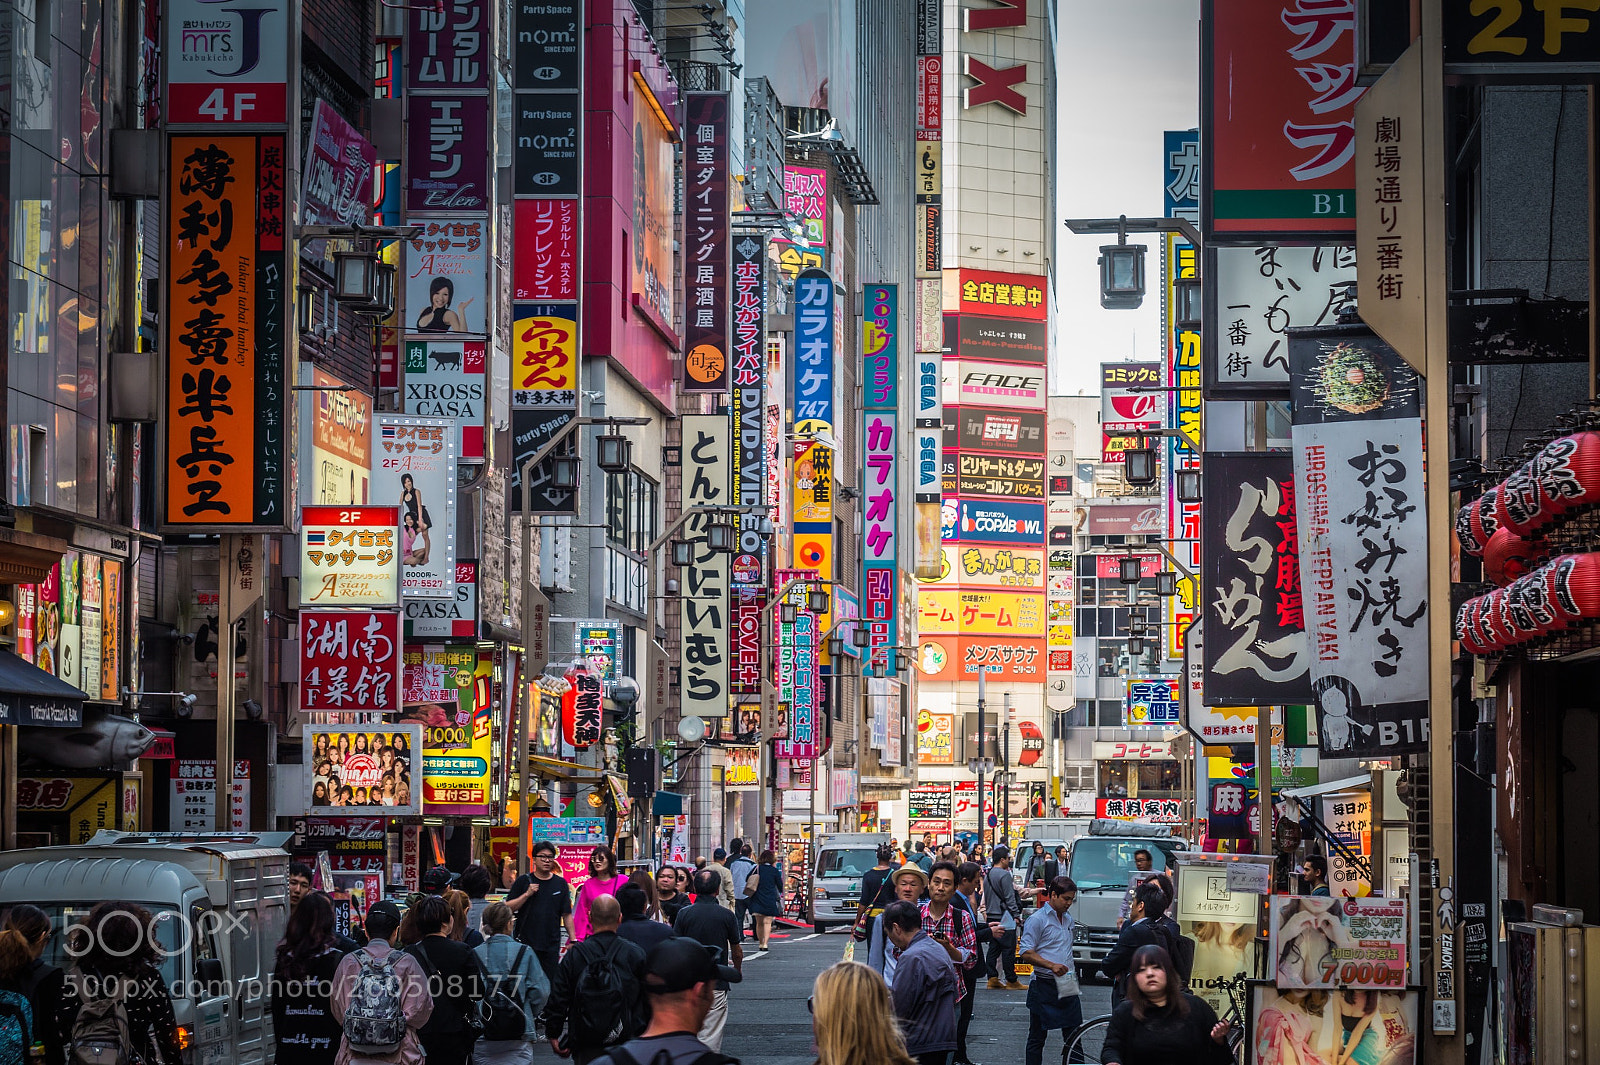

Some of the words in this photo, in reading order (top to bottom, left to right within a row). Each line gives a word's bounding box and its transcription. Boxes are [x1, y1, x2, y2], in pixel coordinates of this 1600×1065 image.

[523, 5, 545, 15] Party
[546, 6, 572, 16] Space
[1466, 0, 1600, 55] 2F
[452, 0, 481, 83] ンタル
[182, 54, 234, 62] Kabukicho
[539, 67, 554, 78] 4F
[198, 88, 257, 121] 4F
[523, 110, 545, 120] Party
[546, 110, 572, 121] Space
[430, 101, 463, 179] エデン
[539, 174, 555, 183] 3F
[260, 146, 283, 237] 炭火串焼
[424, 183, 481, 208] Eden
[787, 196, 822, 219] 求人
[1312, 194, 1347, 214] B1
[1374, 116, 1404, 301] 劇場通り一番街
[427, 223, 481, 237] タイ古式
[560, 201, 571, 258] レンタルルーム
[694, 124, 715, 328] 個室ダイニング居酒屋
[411, 239, 481, 252] マッサージ
[534, 201, 553, 298] リフレッシュ
[238, 255, 250, 293] Hakuri
[560, 261, 571, 294] ホステル
[516, 289, 529, 298] 2F
[962, 280, 1043, 308] 全店営業中
[237, 296, 249, 324] tabai
[734, 261, 761, 385] ホテルがライバル
[799, 279, 829, 396] カラオケ
[979, 330, 1006, 338] しゃぶしゃぶ
[1225, 303, 1252, 378] 一番街
[234, 327, 248, 367] hanbey
[410, 346, 424, 360] 肉
[464, 349, 485, 358] イタリ
[962, 338, 1043, 351] Mo-Mo-Paradise
[408, 359, 425, 368] バル
[467, 357, 482, 365] アン
[920, 362, 936, 411] SEGA
[962, 372, 1043, 390] FACE
[406, 383, 482, 401] XROSS
[514, 391, 575, 406] 博多天神
[416, 400, 476, 417] CASA
[797, 400, 829, 418] 747
[515, 427, 540, 447] Party
[539, 413, 570, 436] Space
[925, 419, 932, 427] 2
[396, 427, 444, 441] タイ古式
[382, 441, 443, 454] マッサージ
[794, 444, 808, 452] 3F
[382, 459, 399, 468] 2F
[920, 436, 936, 486] SEGA
[960, 456, 1043, 479] ビリヤード&ダーツ
[812, 446, 831, 503] 麻雀
[866, 418, 893, 557] カラオケ
[986, 480, 1013, 494] ゴルフ
[1014, 484, 1043, 496] バグース
[1305, 445, 1331, 537] HIROSHIMA
[339, 511, 362, 523] 2F
[328, 529, 394, 547] タイ古式
[307, 550, 394, 566] マッサージ
[962, 549, 1041, 577] まんが喫茶
[1341, 440, 1428, 678] お好み焼き
[868, 571, 891, 600] 24
[405, 602, 463, 619] CASA
[874, 601, 885, 618] H
[962, 605, 1013, 628] ゲーム
[306, 613, 394, 664] 湖南
[1050, 632, 1071, 640] ゲーム
[965, 644, 1038, 664] メンズサウナ
[403, 667, 458, 678] ーストビーフ
[795, 614, 812, 742] 歌舞伎町案内所
[965, 665, 979, 673] 24H
[324, 665, 392, 709] 菜館
[412, 678, 440, 688] 生ハム
[1132, 685, 1170, 702] 完全
[1112, 743, 1163, 758] コーヒー
[433, 789, 483, 801] 受付3F
[97, 801, 107, 828] Tuna
[1196, 902, 1241, 912] オイルマッサージ
[1343, 901, 1404, 917] G-SCANDAL
[1331, 948, 1399, 960] 初回のお客様
[1322, 961, 1404, 986] 7,000円
